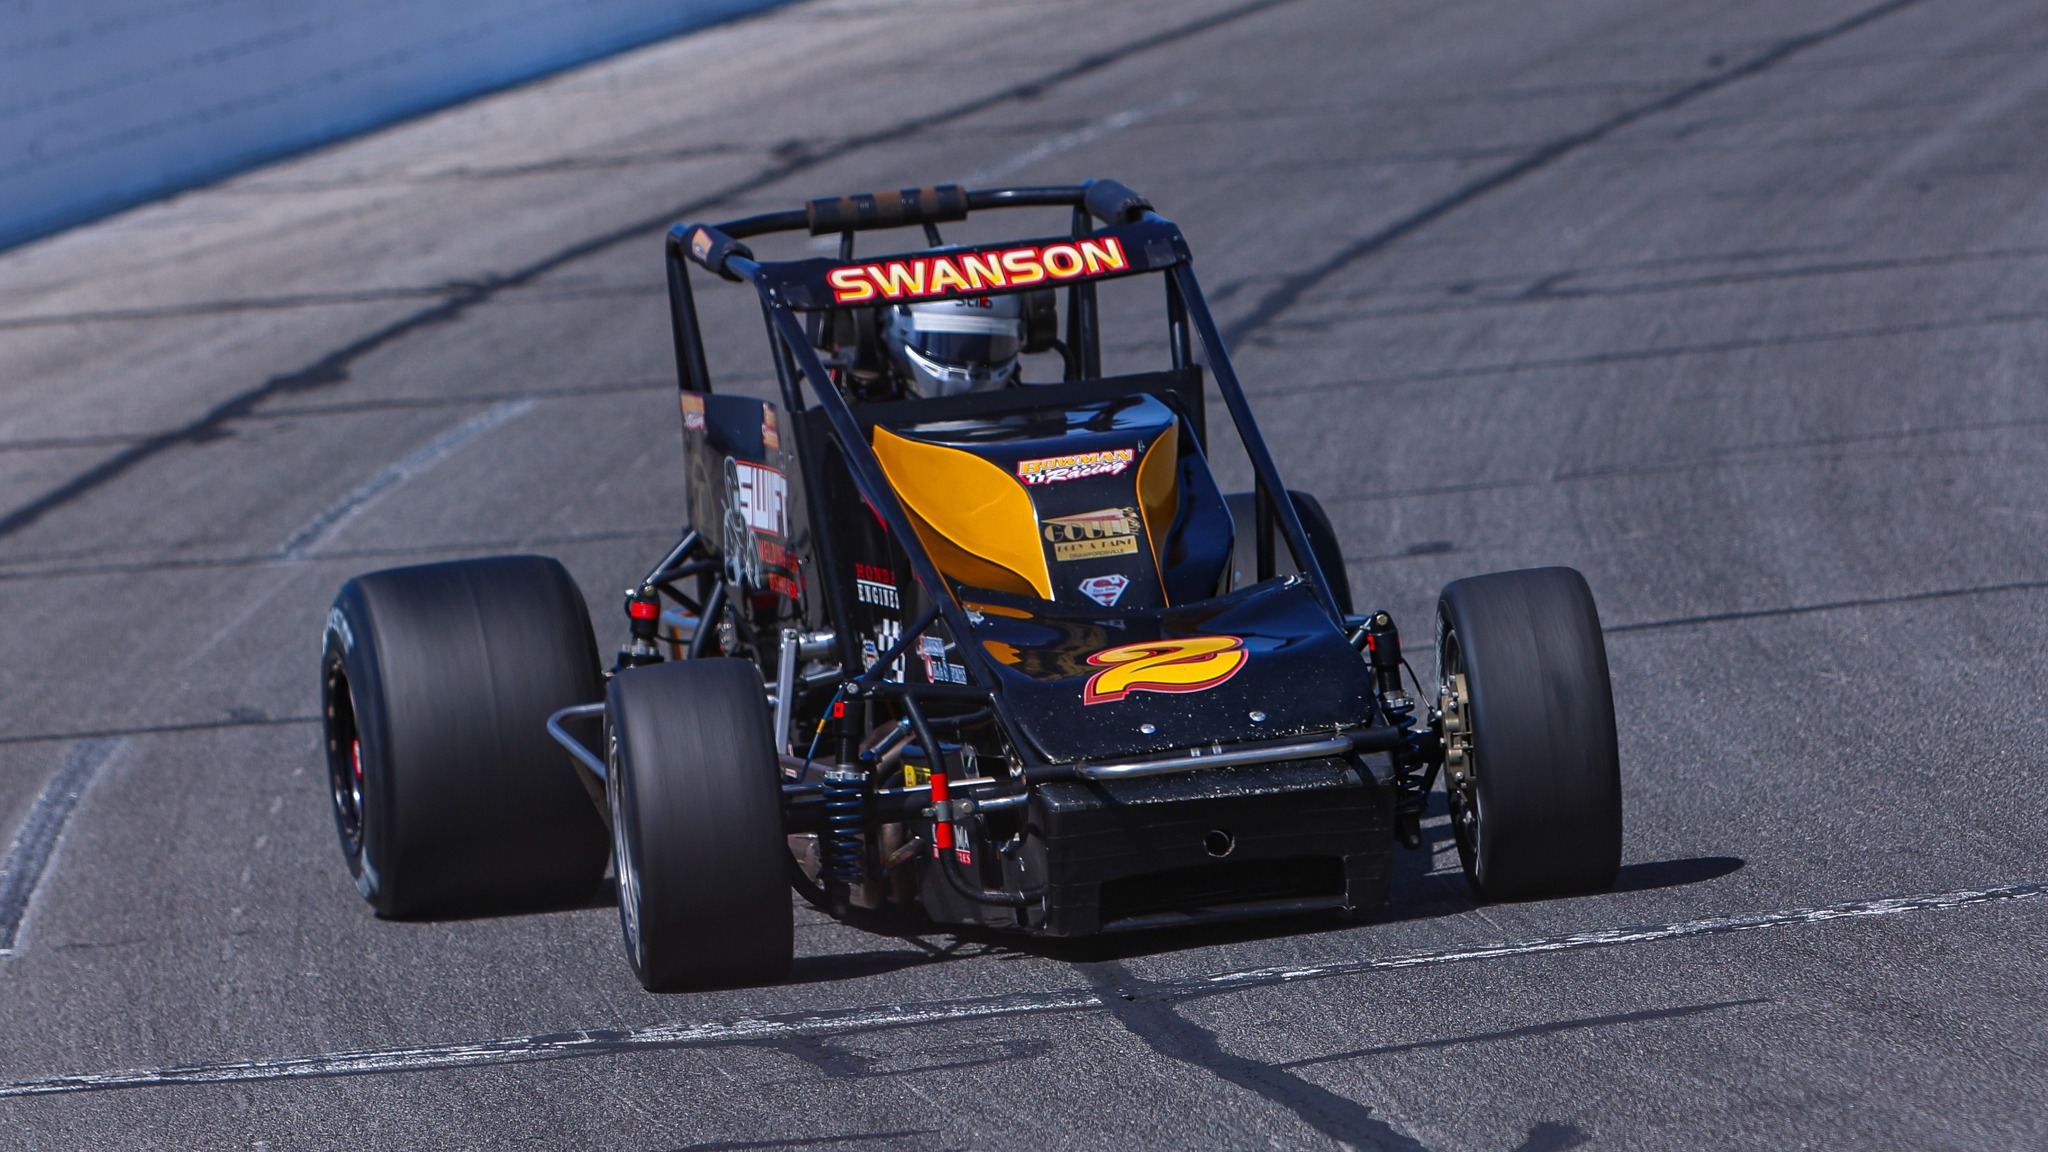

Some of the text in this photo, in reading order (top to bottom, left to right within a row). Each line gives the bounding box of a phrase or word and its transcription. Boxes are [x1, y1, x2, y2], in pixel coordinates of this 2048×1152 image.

[827, 237, 1129, 303] SWANSON
[1020, 449, 1134, 475] BOWMAN
[1044, 460, 1128, 484] Racing
[1083, 635, 1249, 706] 2
